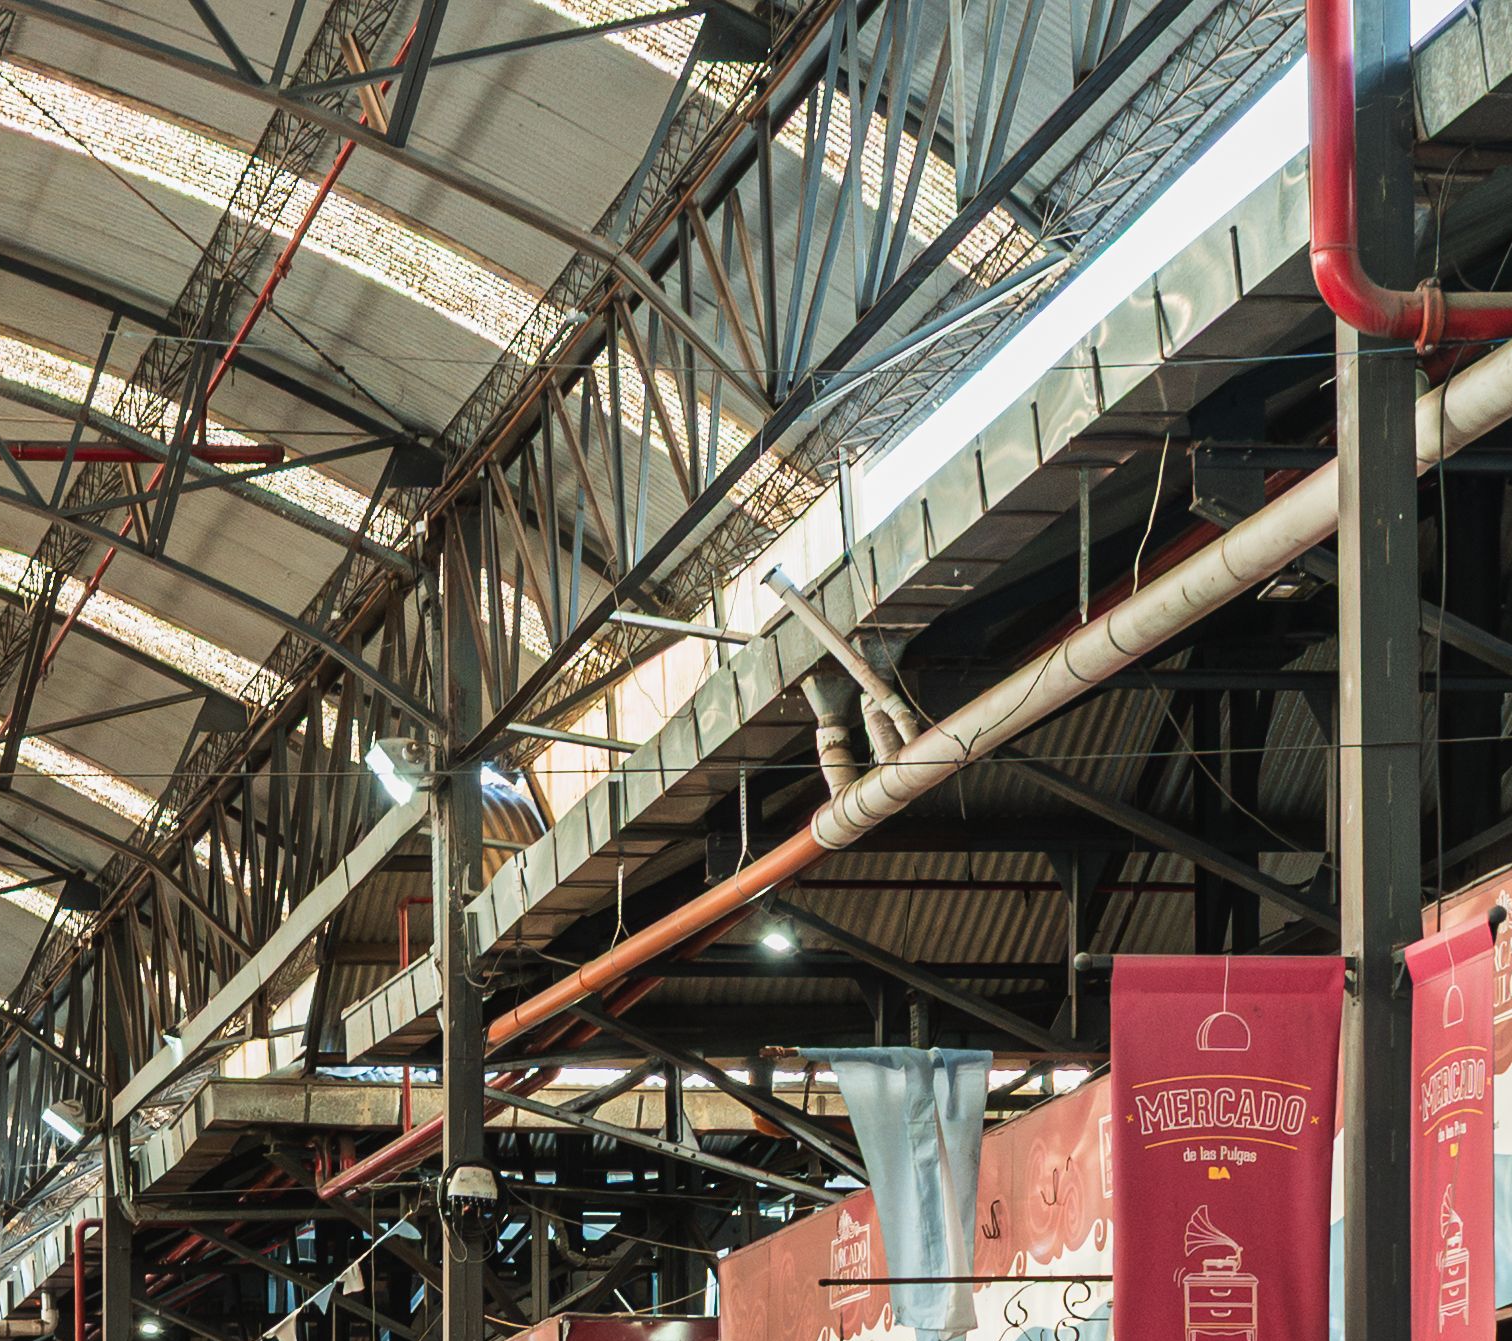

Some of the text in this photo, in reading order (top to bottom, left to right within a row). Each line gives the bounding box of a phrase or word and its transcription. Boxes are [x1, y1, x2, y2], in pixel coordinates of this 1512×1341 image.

[1421, 1058, 1486, 1123] MERCADO
[1135, 1087, 1307, 1136] MERCADO
[1183, 1146, 1257, 1166] de las Pulgas
[1208, 1166, 1231, 1180] BA
